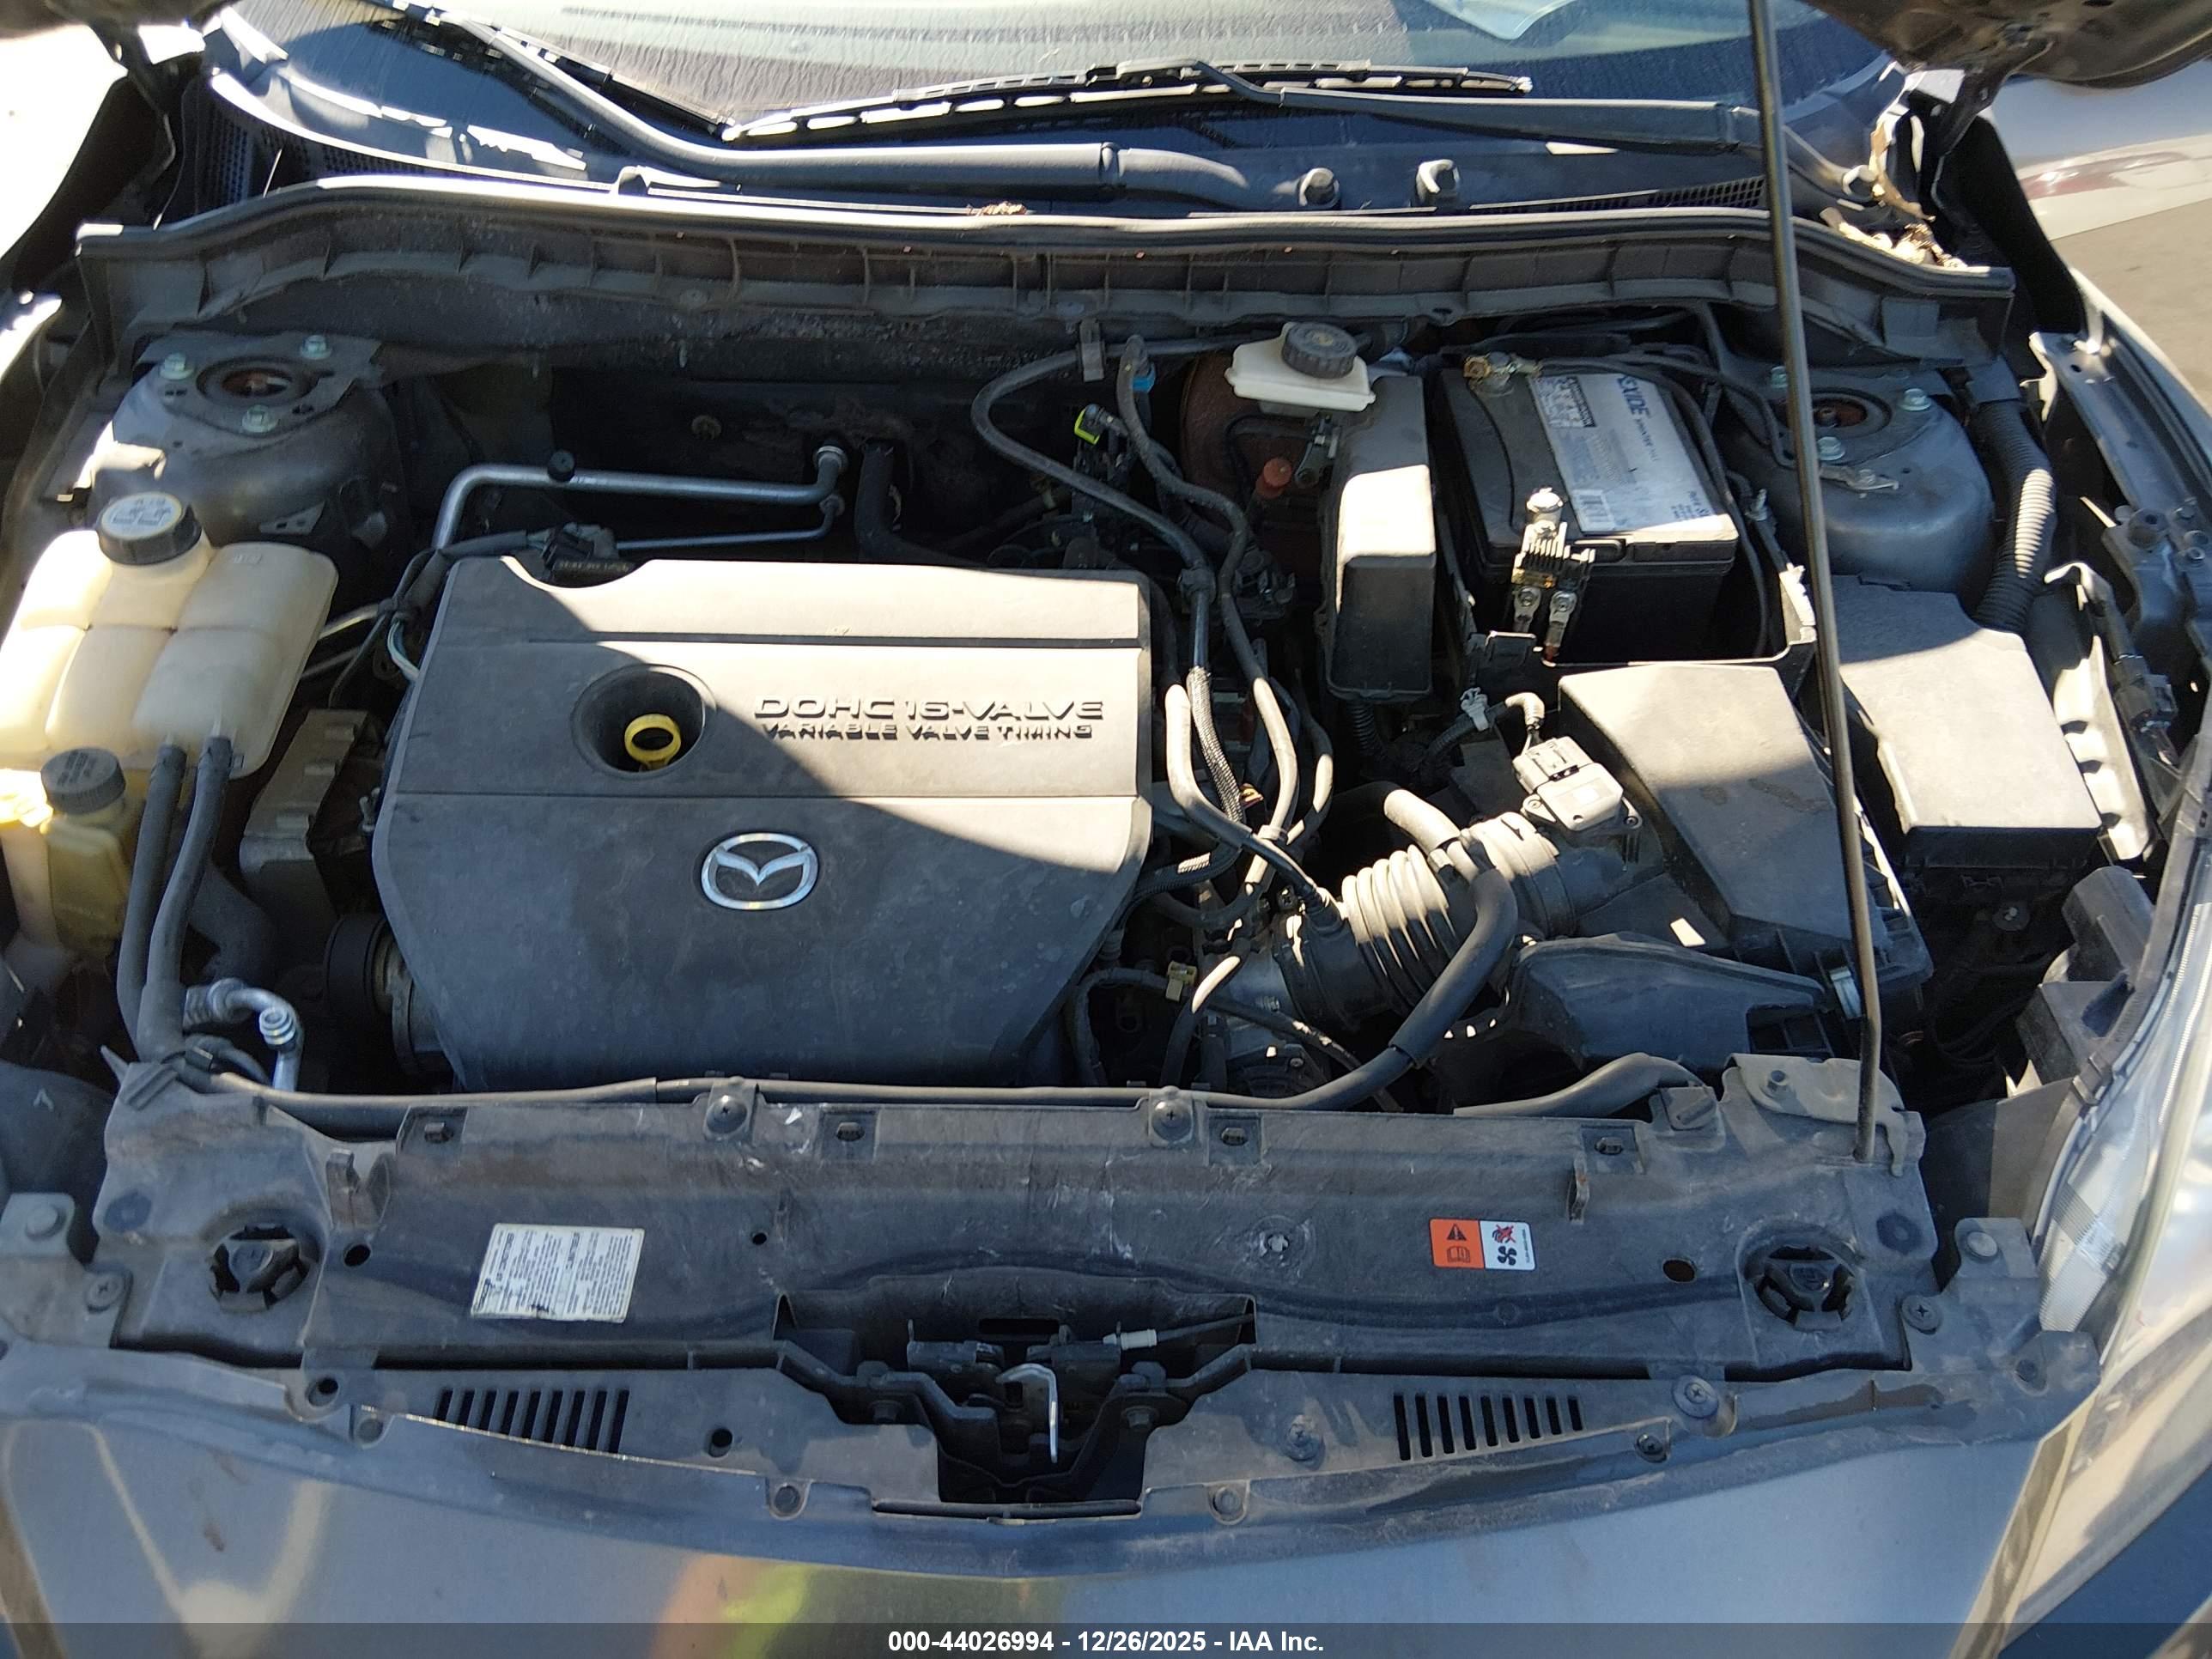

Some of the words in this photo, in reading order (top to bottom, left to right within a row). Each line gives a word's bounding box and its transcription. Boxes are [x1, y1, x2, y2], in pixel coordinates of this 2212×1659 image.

[755, 696, 895, 720] DOHC
[904, 699, 1104, 721] 16-VALVE
[762, 722, 898, 741] VARIABLE
[906, 723, 990, 741] VALVE
[997, 724, 1093, 740] TIMING
